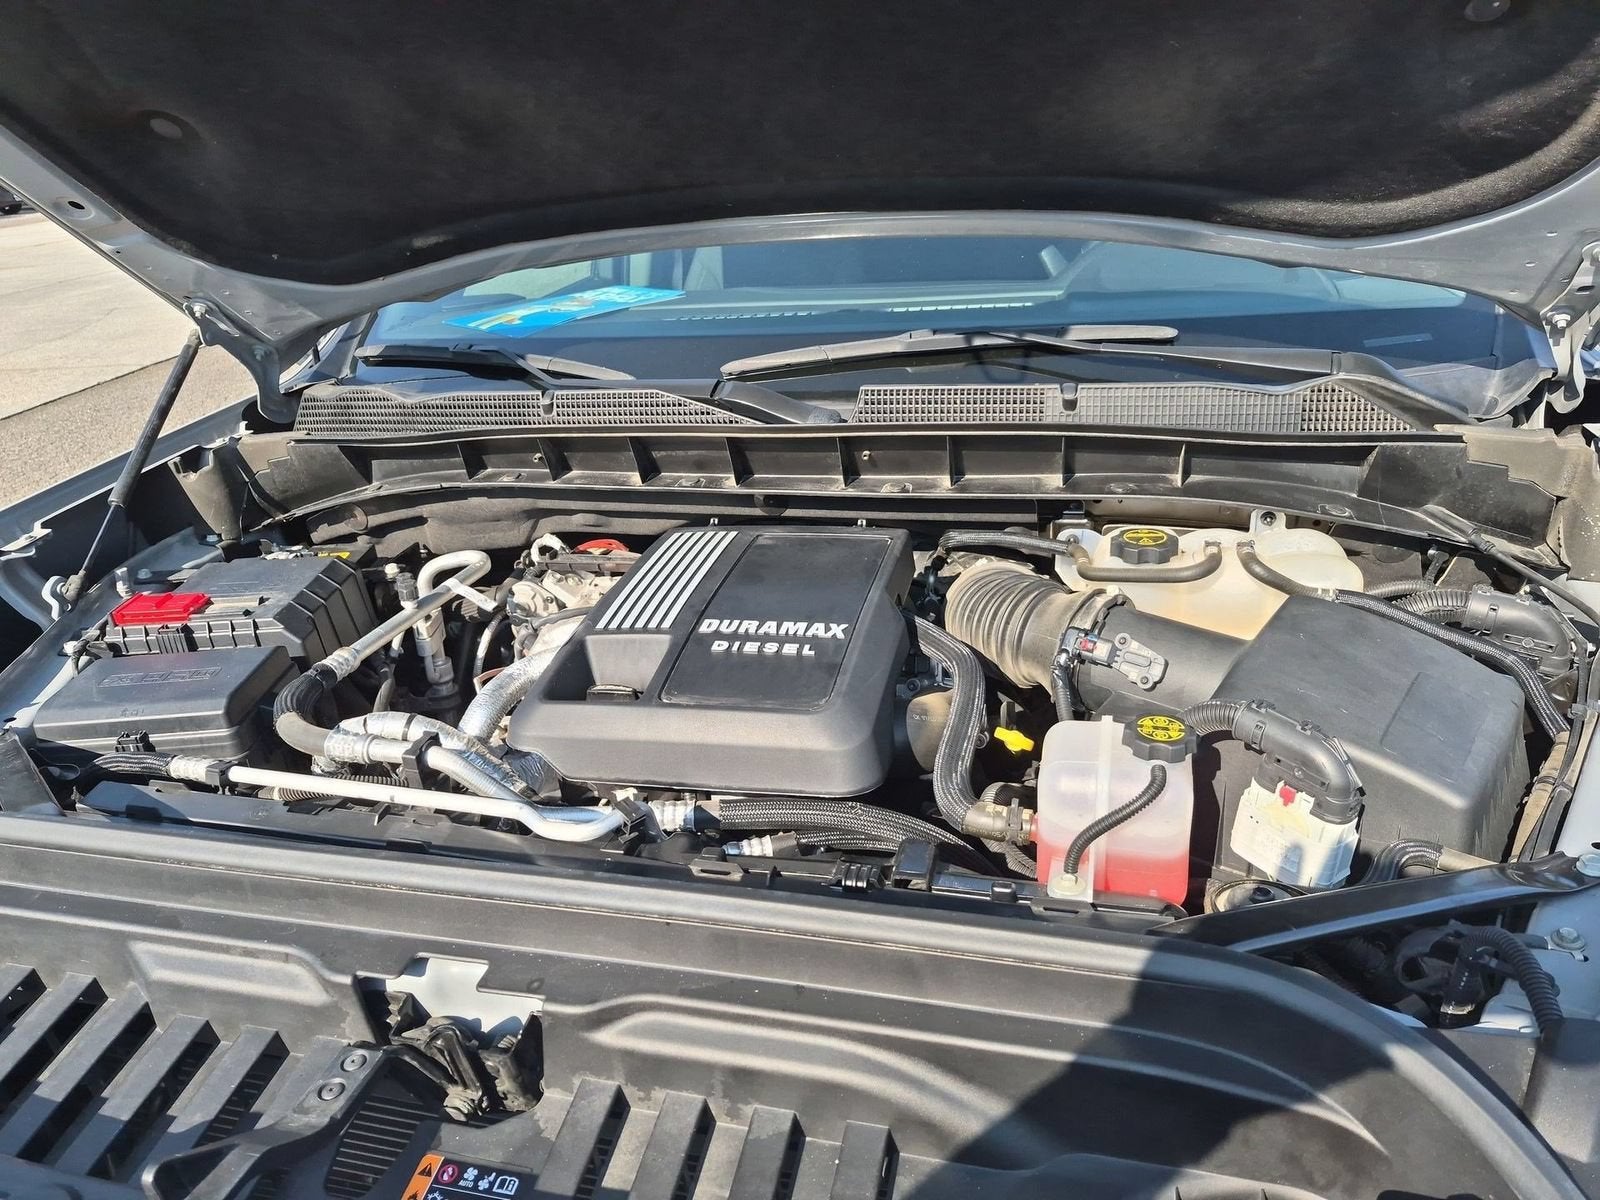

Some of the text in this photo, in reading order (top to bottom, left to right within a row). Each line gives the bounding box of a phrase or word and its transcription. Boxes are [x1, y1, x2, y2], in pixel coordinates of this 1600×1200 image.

[698, 618, 849, 639] DURAMAX
[711, 640, 816, 656] DIESEL
[458, 1180, 474, 1188] AUTO
